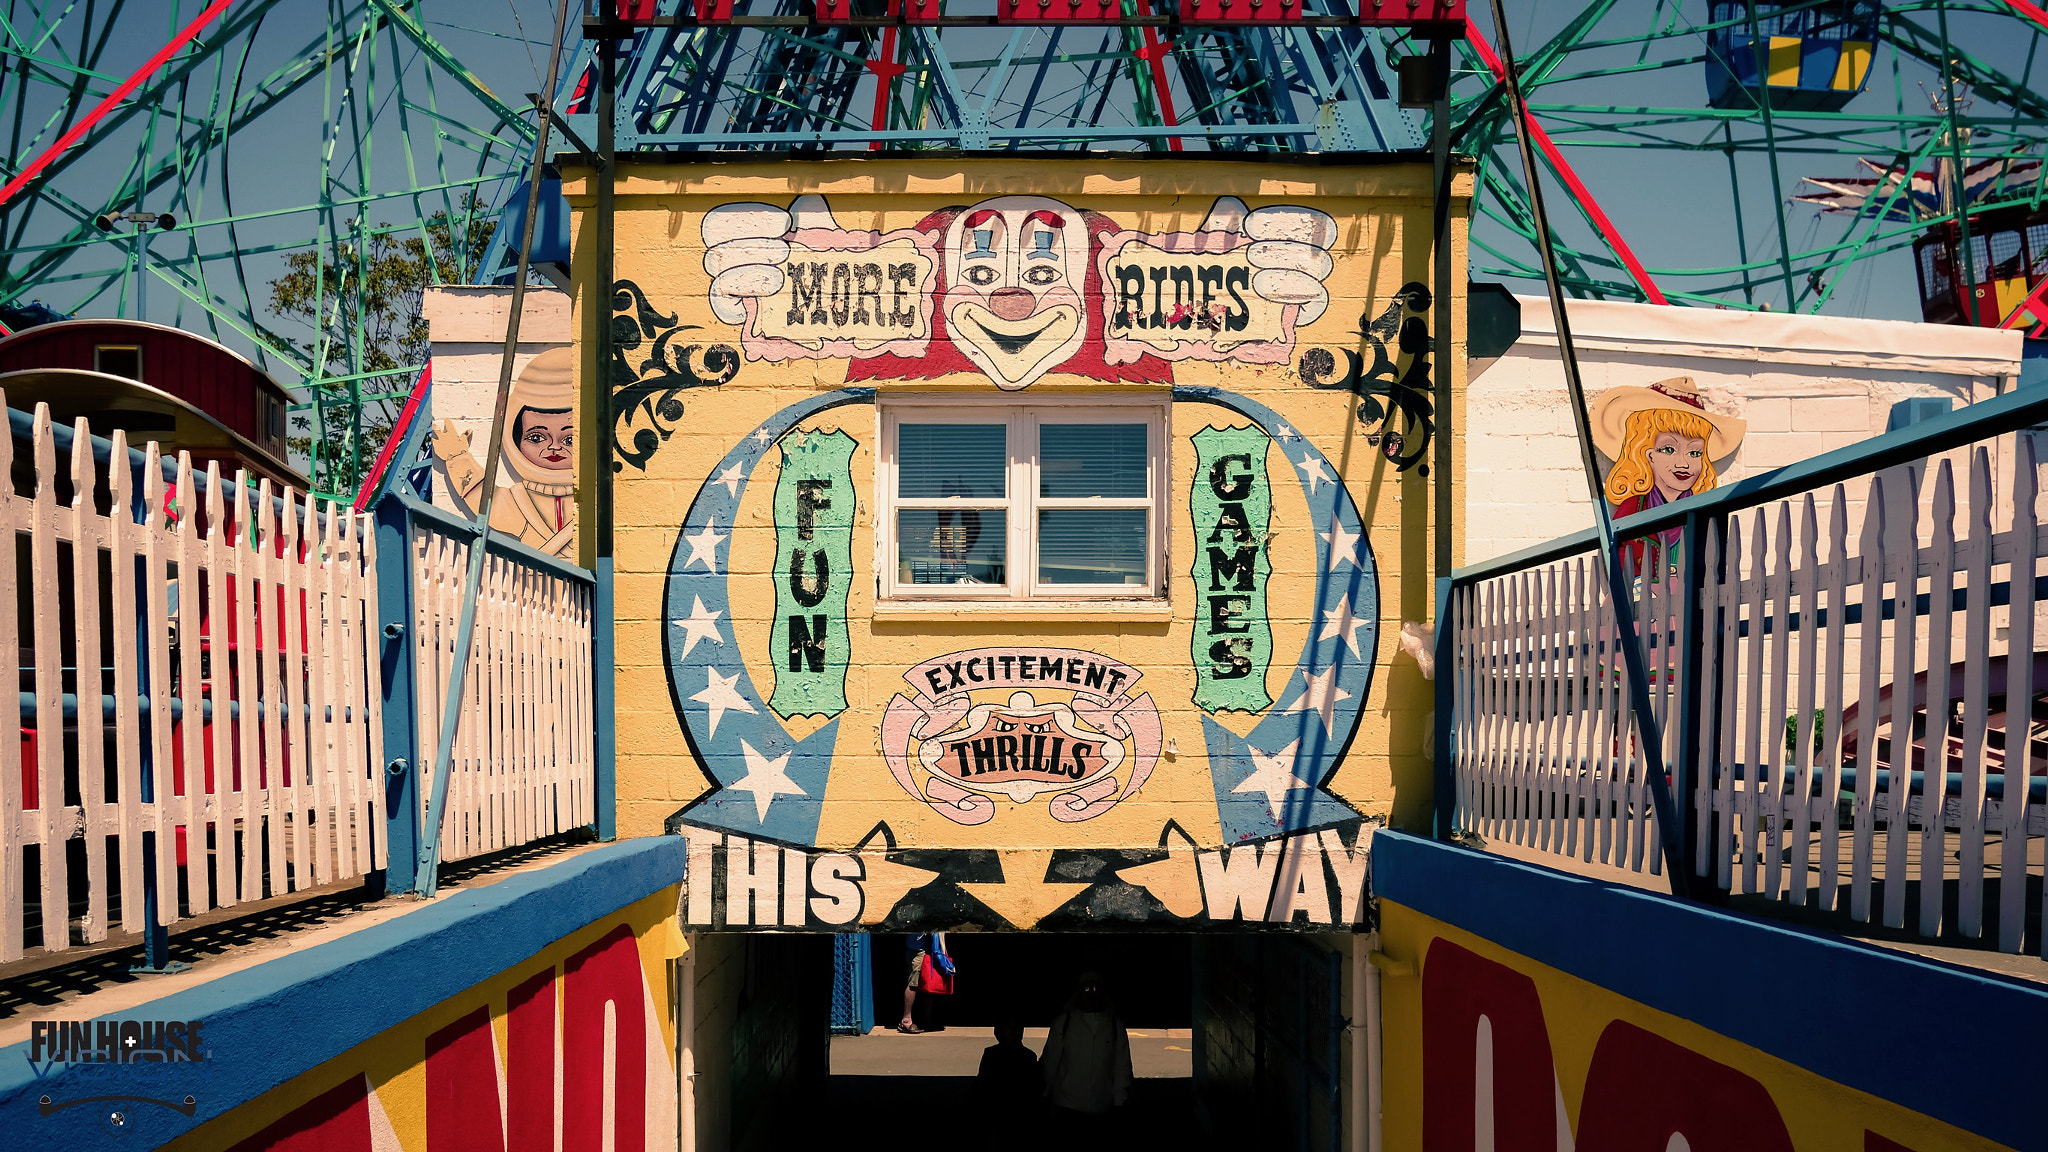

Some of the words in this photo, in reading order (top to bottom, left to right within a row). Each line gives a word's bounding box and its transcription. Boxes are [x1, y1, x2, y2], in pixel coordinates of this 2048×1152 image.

[787, 262, 917, 327] MORE
[1116, 265, 1249, 332] RIDES
[789, 480, 832, 673] FUN
[1206, 453, 1259, 680] GAMES
[925, 656, 1128, 695] EXCITEMENT
[951, 734, 1092, 780] THRILLS
[680, 824, 862, 925] THIS
[1199, 821, 1379, 924] WAY
